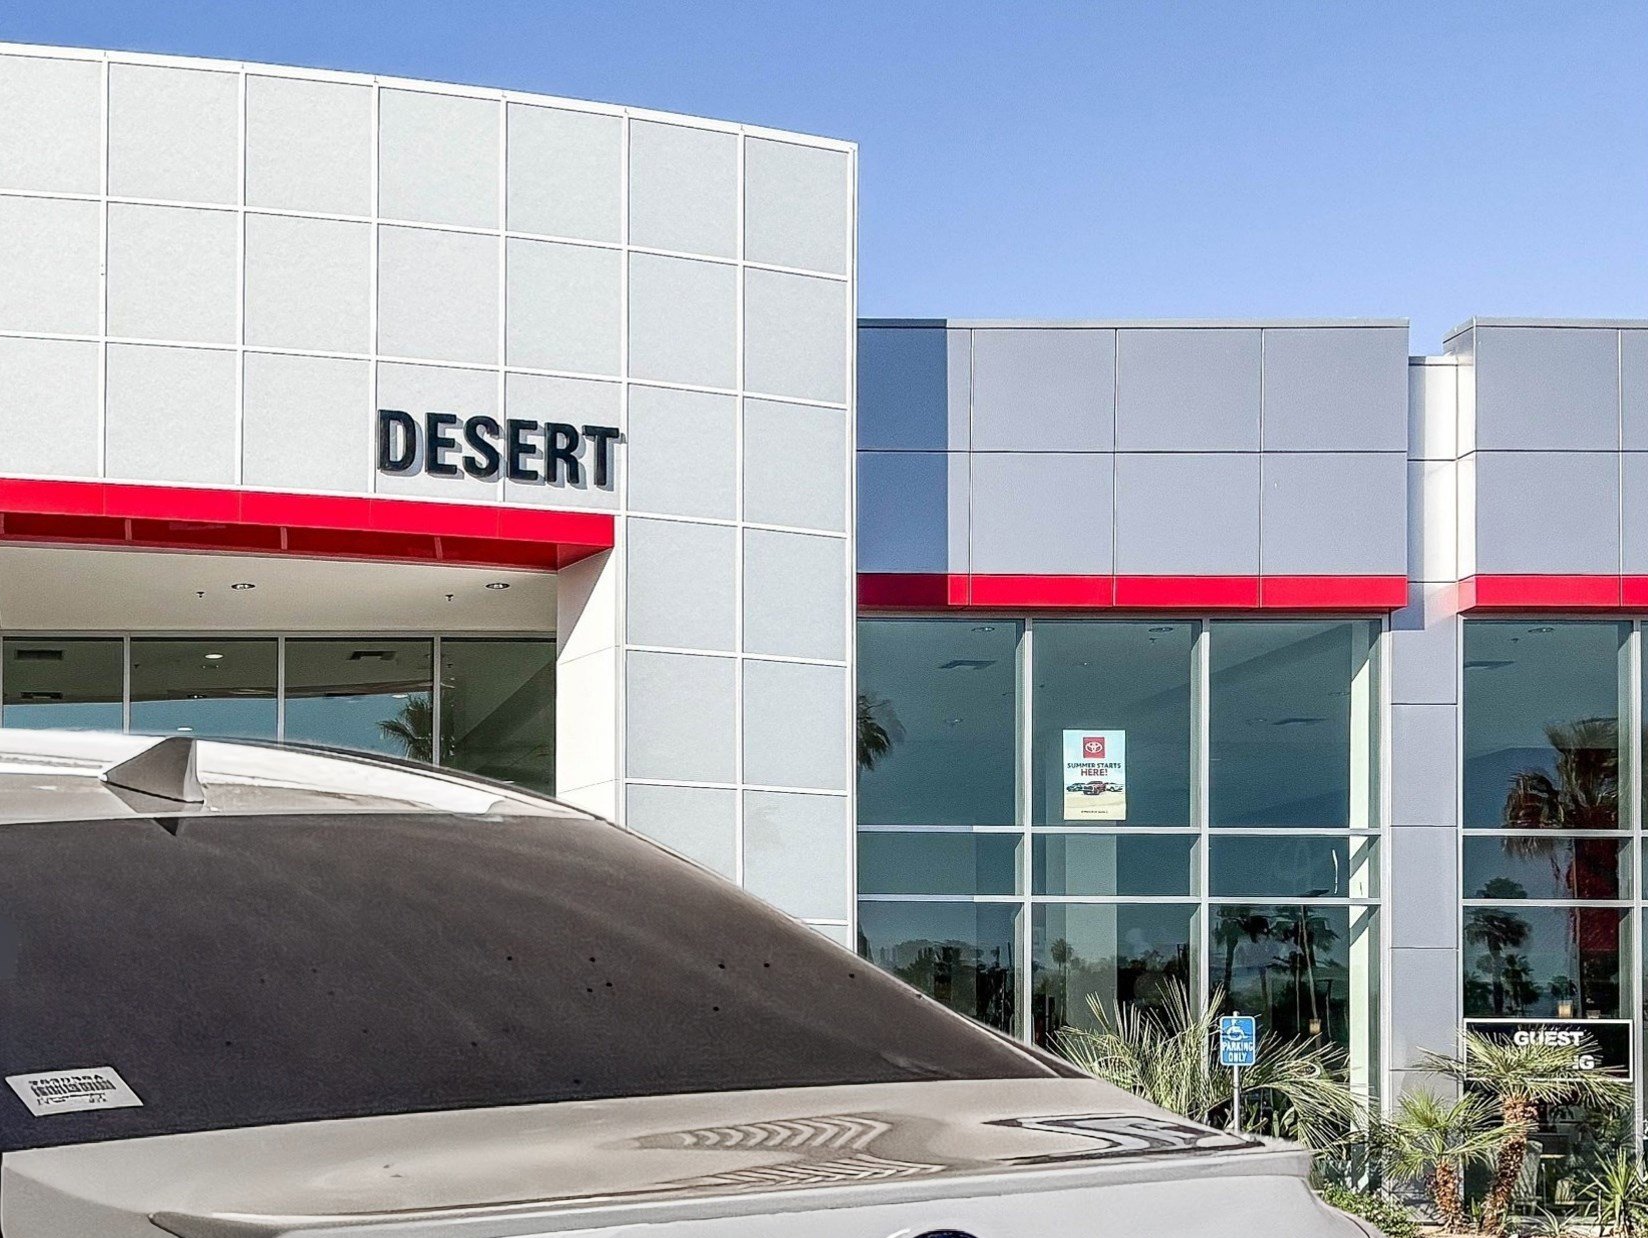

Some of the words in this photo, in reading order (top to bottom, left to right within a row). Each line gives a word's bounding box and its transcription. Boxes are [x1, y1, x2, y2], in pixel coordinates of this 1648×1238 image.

[377, 409, 620, 487] DESERT
[1080, 768, 1108, 776] HERE!
[1513, 1030, 1585, 1047] GUEST
[1222, 1041, 1253, 1051] PARKING
[1228, 1052, 1248, 1063] ONLY
